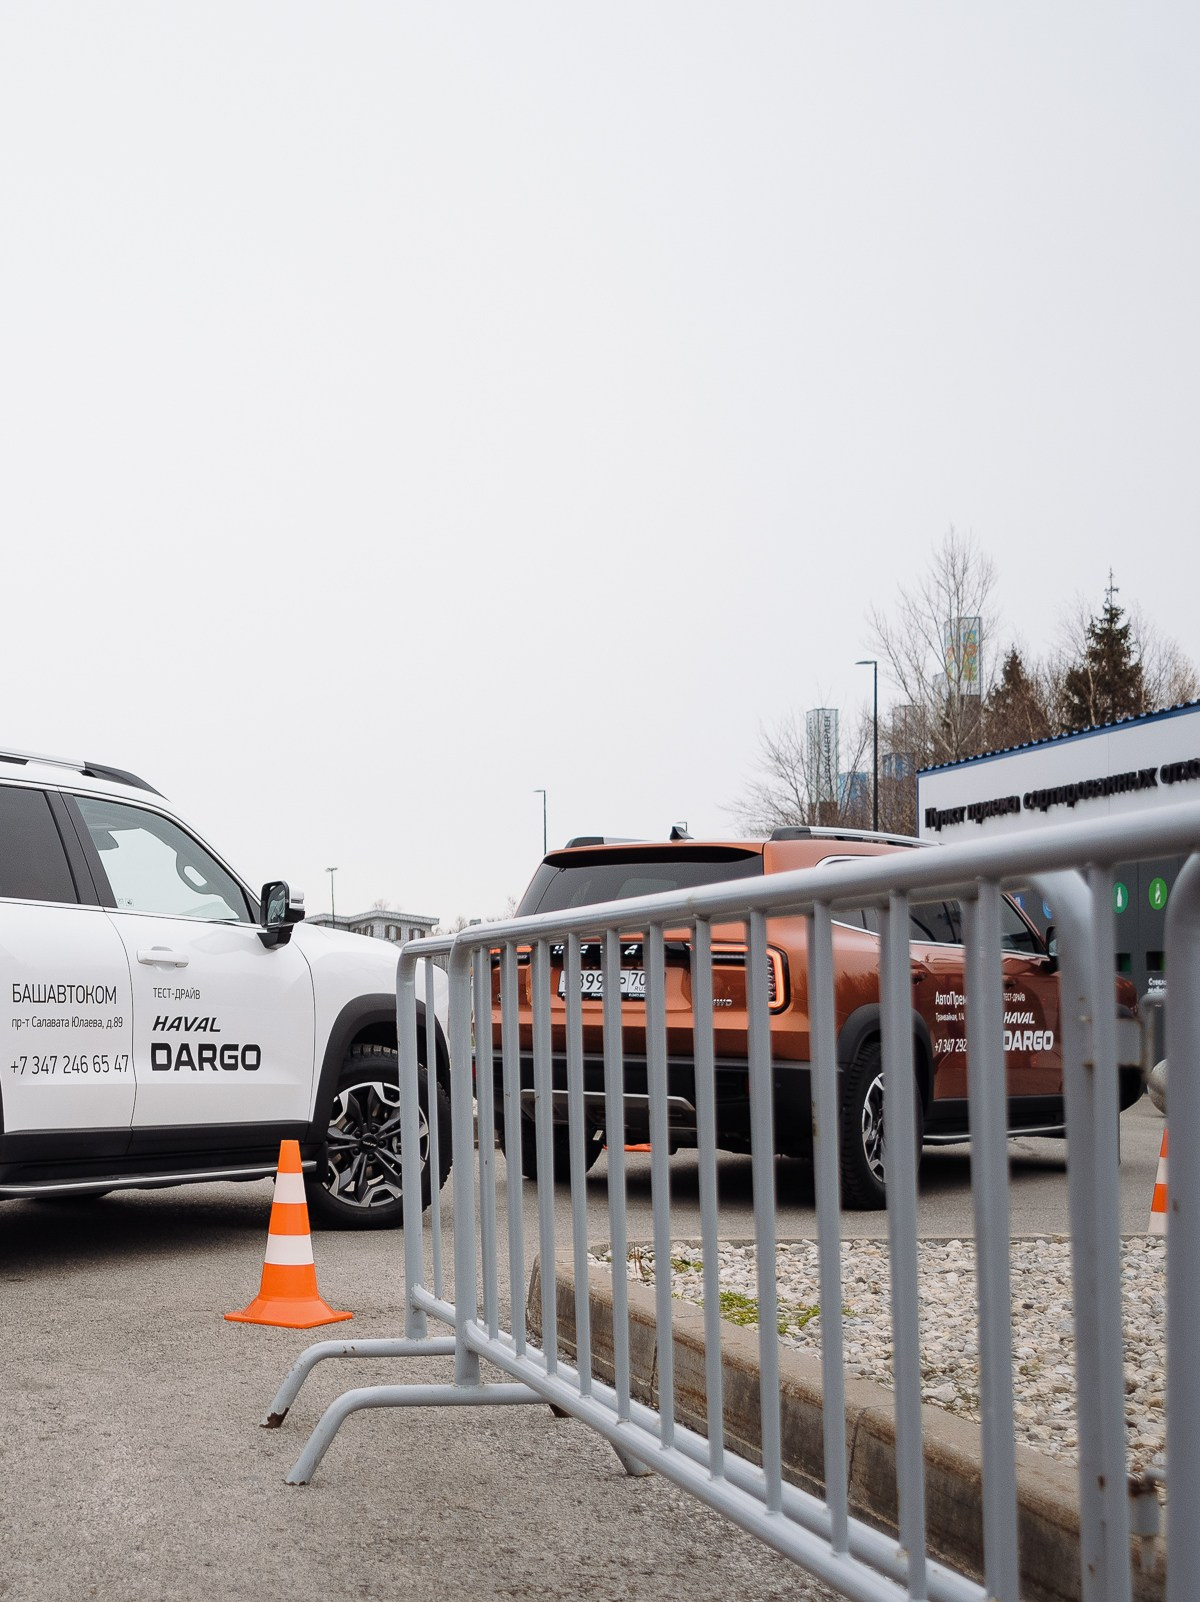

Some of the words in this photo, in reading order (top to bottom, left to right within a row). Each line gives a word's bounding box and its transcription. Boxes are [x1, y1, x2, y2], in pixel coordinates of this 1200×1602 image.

[925, 806, 967, 832] Пункт
[11, 983, 118, 1005] БАШАВТОКОМ
[152, 986, 201, 1001] ТЕСТ-ДРАЙВ
[11, 1018, 30, 1031] пр-т
[31, 1015, 70, 1028] Салавата
[71, 1015, 105, 1030] Юлаева,
[106, 1016, 124, 1030] д.89
[152, 1015, 222, 1033] HAVAL
[1003, 1011, 1035, 1024] HAVAL
[1002, 1030, 1054, 1051] DARGO
[10, 1055, 28, 1075] +7
[31, 1055, 58, 1075] 347
[63, 1054, 89, 1074] 246
[93, 1054, 110, 1074] 65
[114, 1054, 129, 1073] 47
[150, 1042, 262, 1072] DARGO
